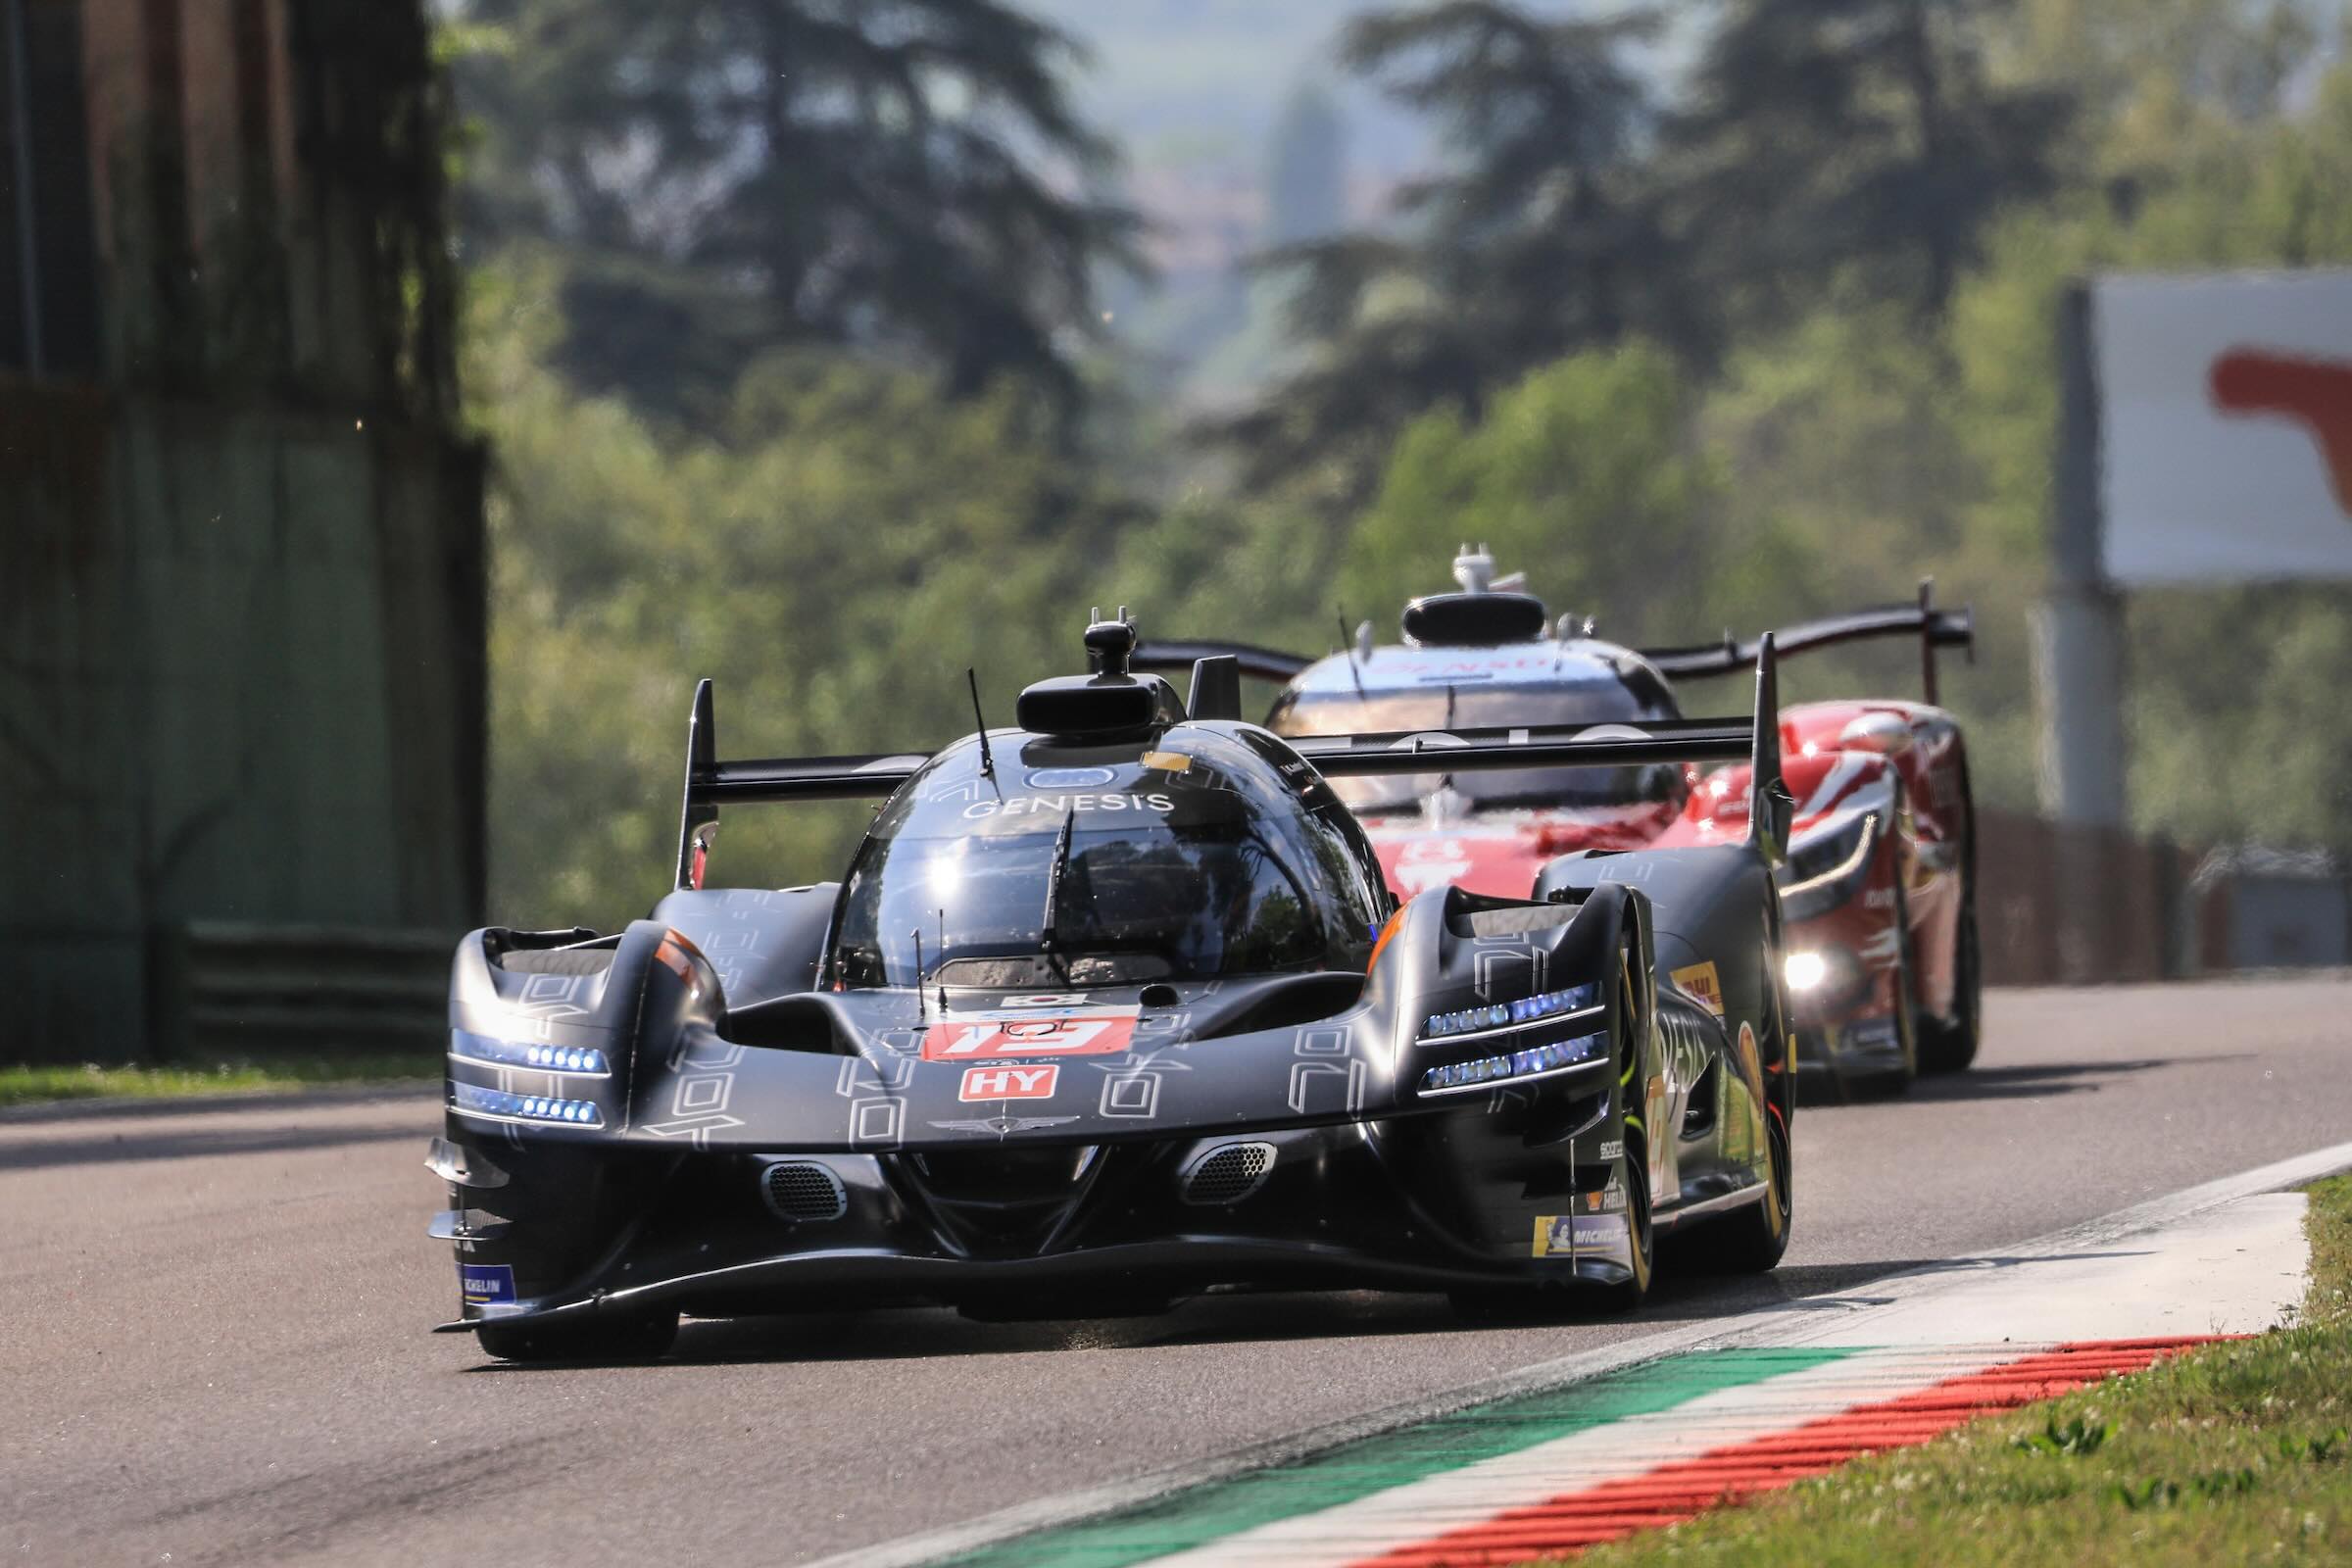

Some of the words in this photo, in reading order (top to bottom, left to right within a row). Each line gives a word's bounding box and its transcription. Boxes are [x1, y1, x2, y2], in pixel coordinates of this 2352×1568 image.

[962, 793, 1175, 819] GENESIS
[944, 1020, 1113, 1054] 19
[969, 1069, 1049, 1095] HY
